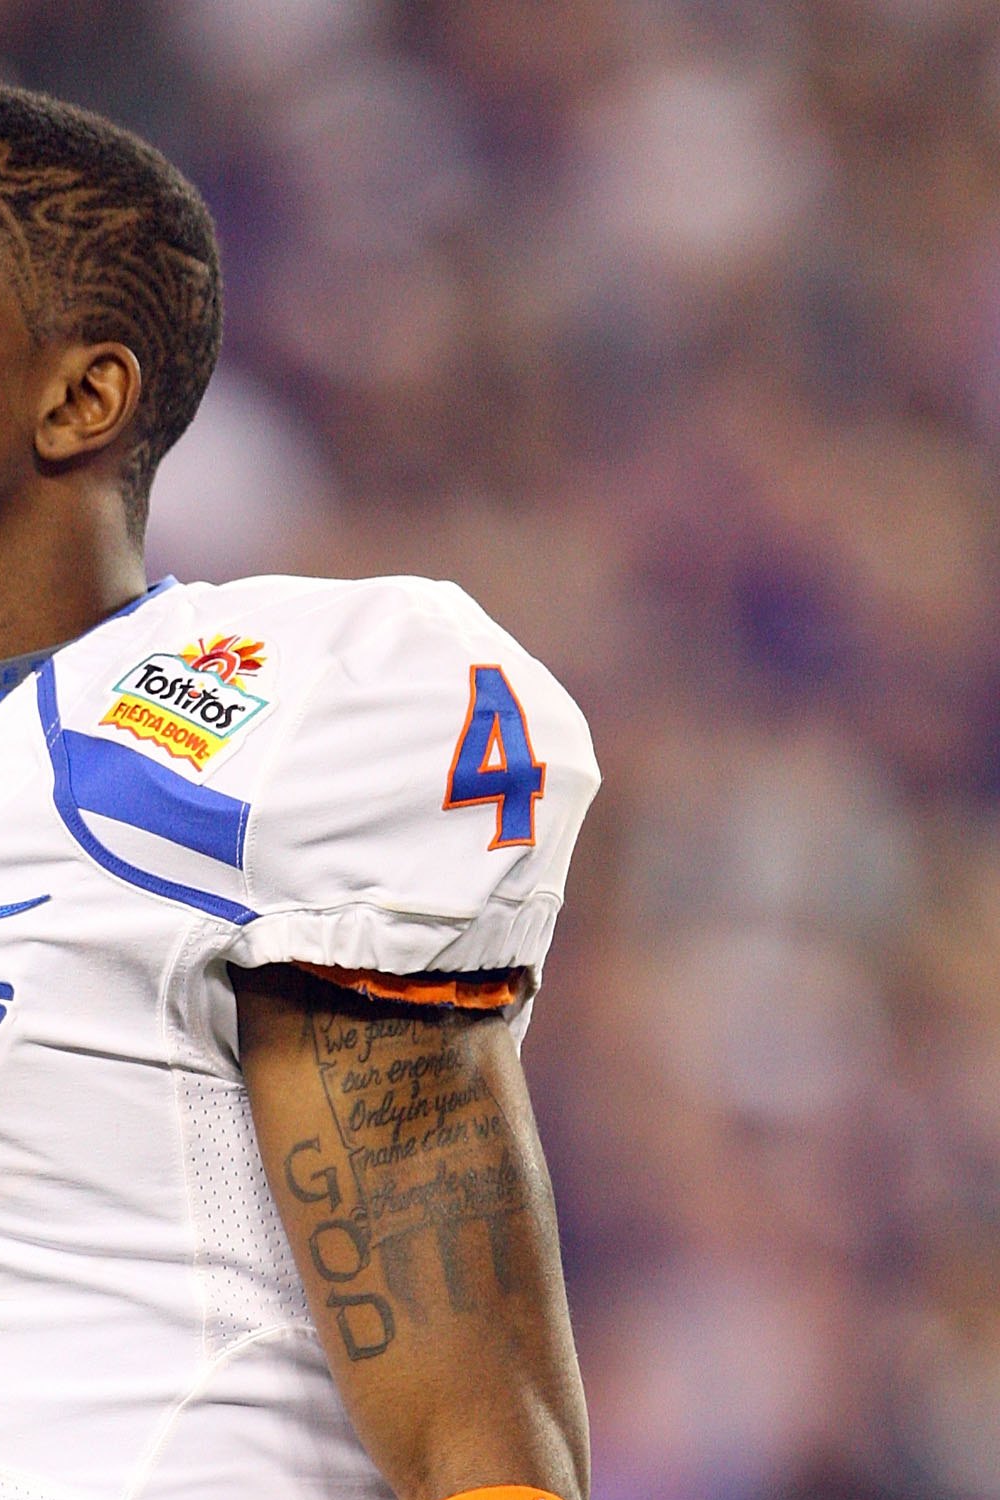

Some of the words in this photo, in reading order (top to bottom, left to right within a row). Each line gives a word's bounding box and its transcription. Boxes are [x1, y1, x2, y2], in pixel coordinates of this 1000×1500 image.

[113, 701, 163, 732] FIESTA
[161, 721, 210, 760] BOWL
[442, 664, 547, 851] 4
[284, 1138, 396, 1362] GOD
